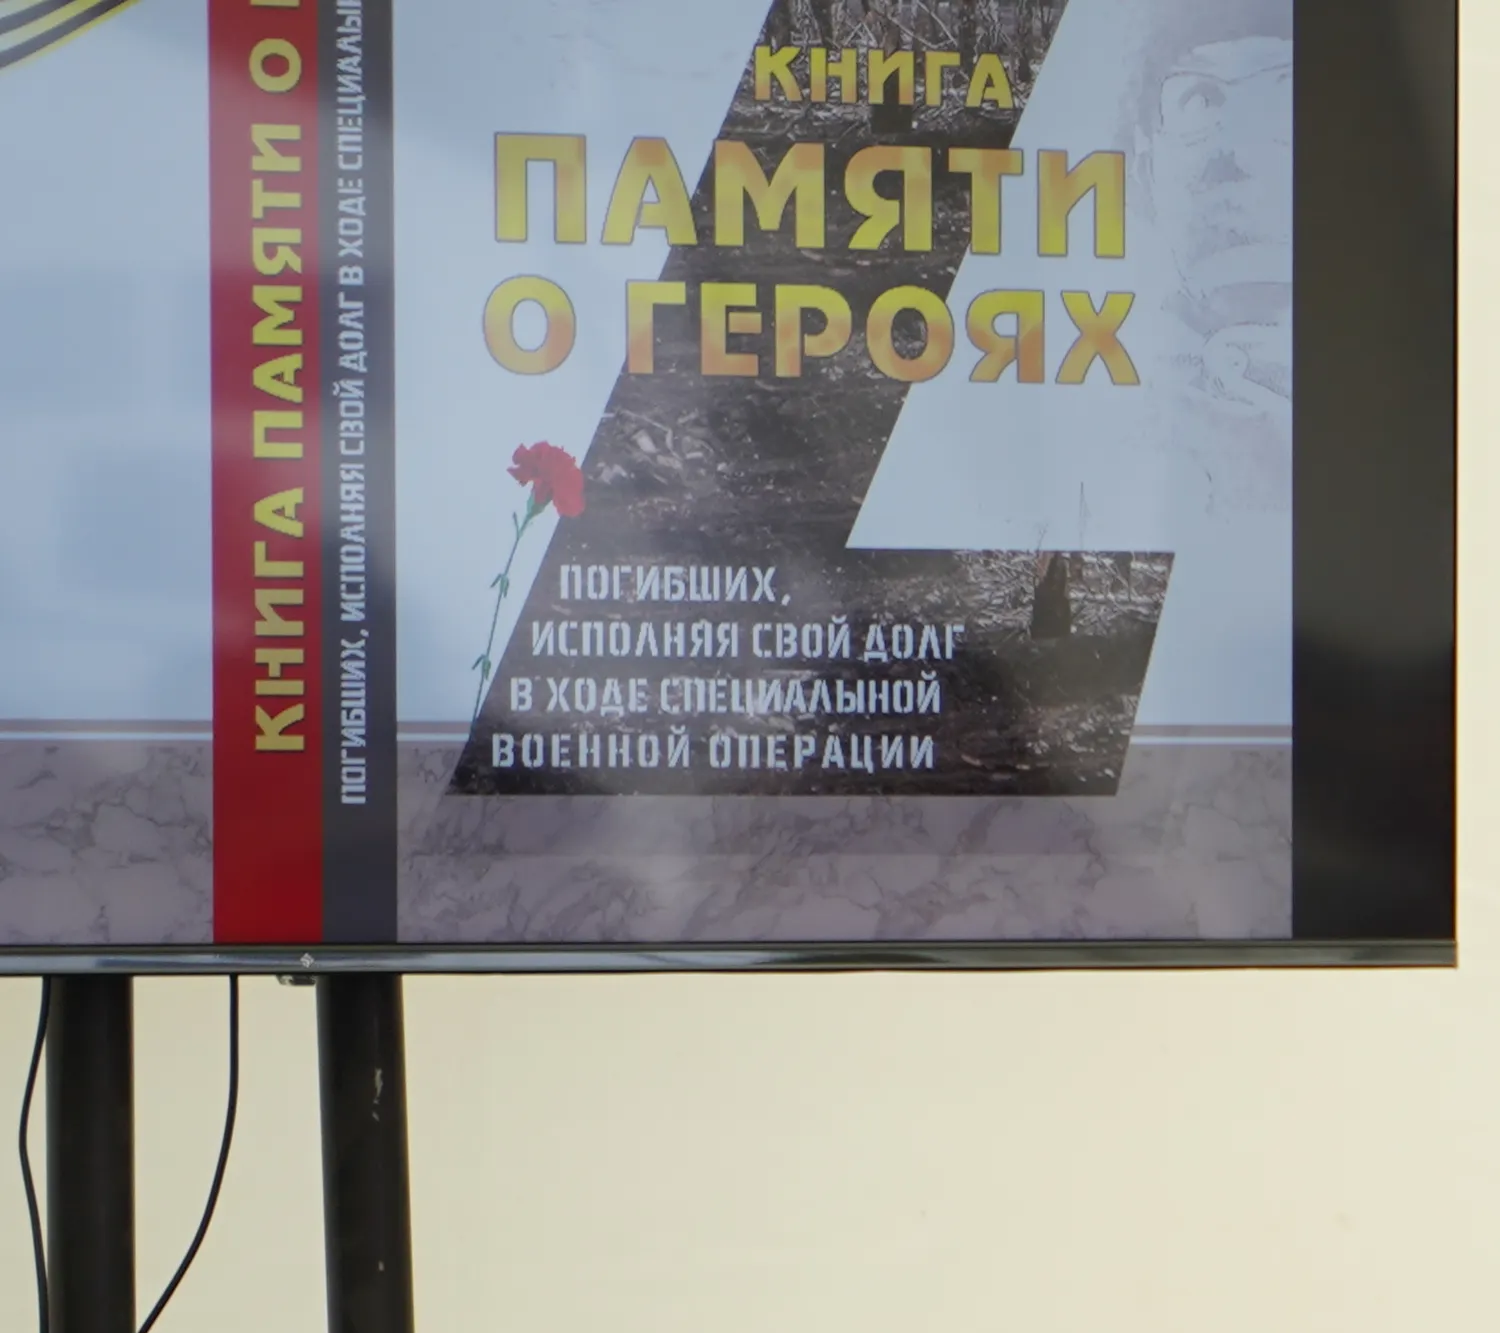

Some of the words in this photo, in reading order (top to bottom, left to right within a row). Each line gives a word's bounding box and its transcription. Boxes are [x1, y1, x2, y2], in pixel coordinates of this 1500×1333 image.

[249, 38, 302, 93] О
[754, 45, 1015, 109] КНИГА
[337, 177, 366, 258] ХОДЕ
[494, 131, 1126, 259] ПАМЯТИ
[251, 123, 303, 460] ПАМЯТИ
[338, 264, 365, 286] В
[338, 291, 368, 373] ДОЛГ
[482, 275, 577, 376] О
[626, 279, 1141, 387] ГЕРОЯХ
[332, 378, 366, 456] СВОЙ
[340, 463, 366, 622] ИСПОЛНЯЯ
[254, 486, 304, 751] КНИГА
[559, 564, 791, 607] ПОГИБШИХ,
[531, 620, 739, 658] ИСПОЛНЯЯ
[752, 614, 851, 659] СВОЙ
[863, 624, 965, 664] ДОЛГ
[340, 628, 369, 804] ПОГИБШИХ,
[509, 676, 533, 712] В
[545, 676, 649, 718] ХОДЕ
[491, 724, 692, 769] ВОЕННОЙ
[708, 732, 935, 774] ОПЕРАЦИИ
